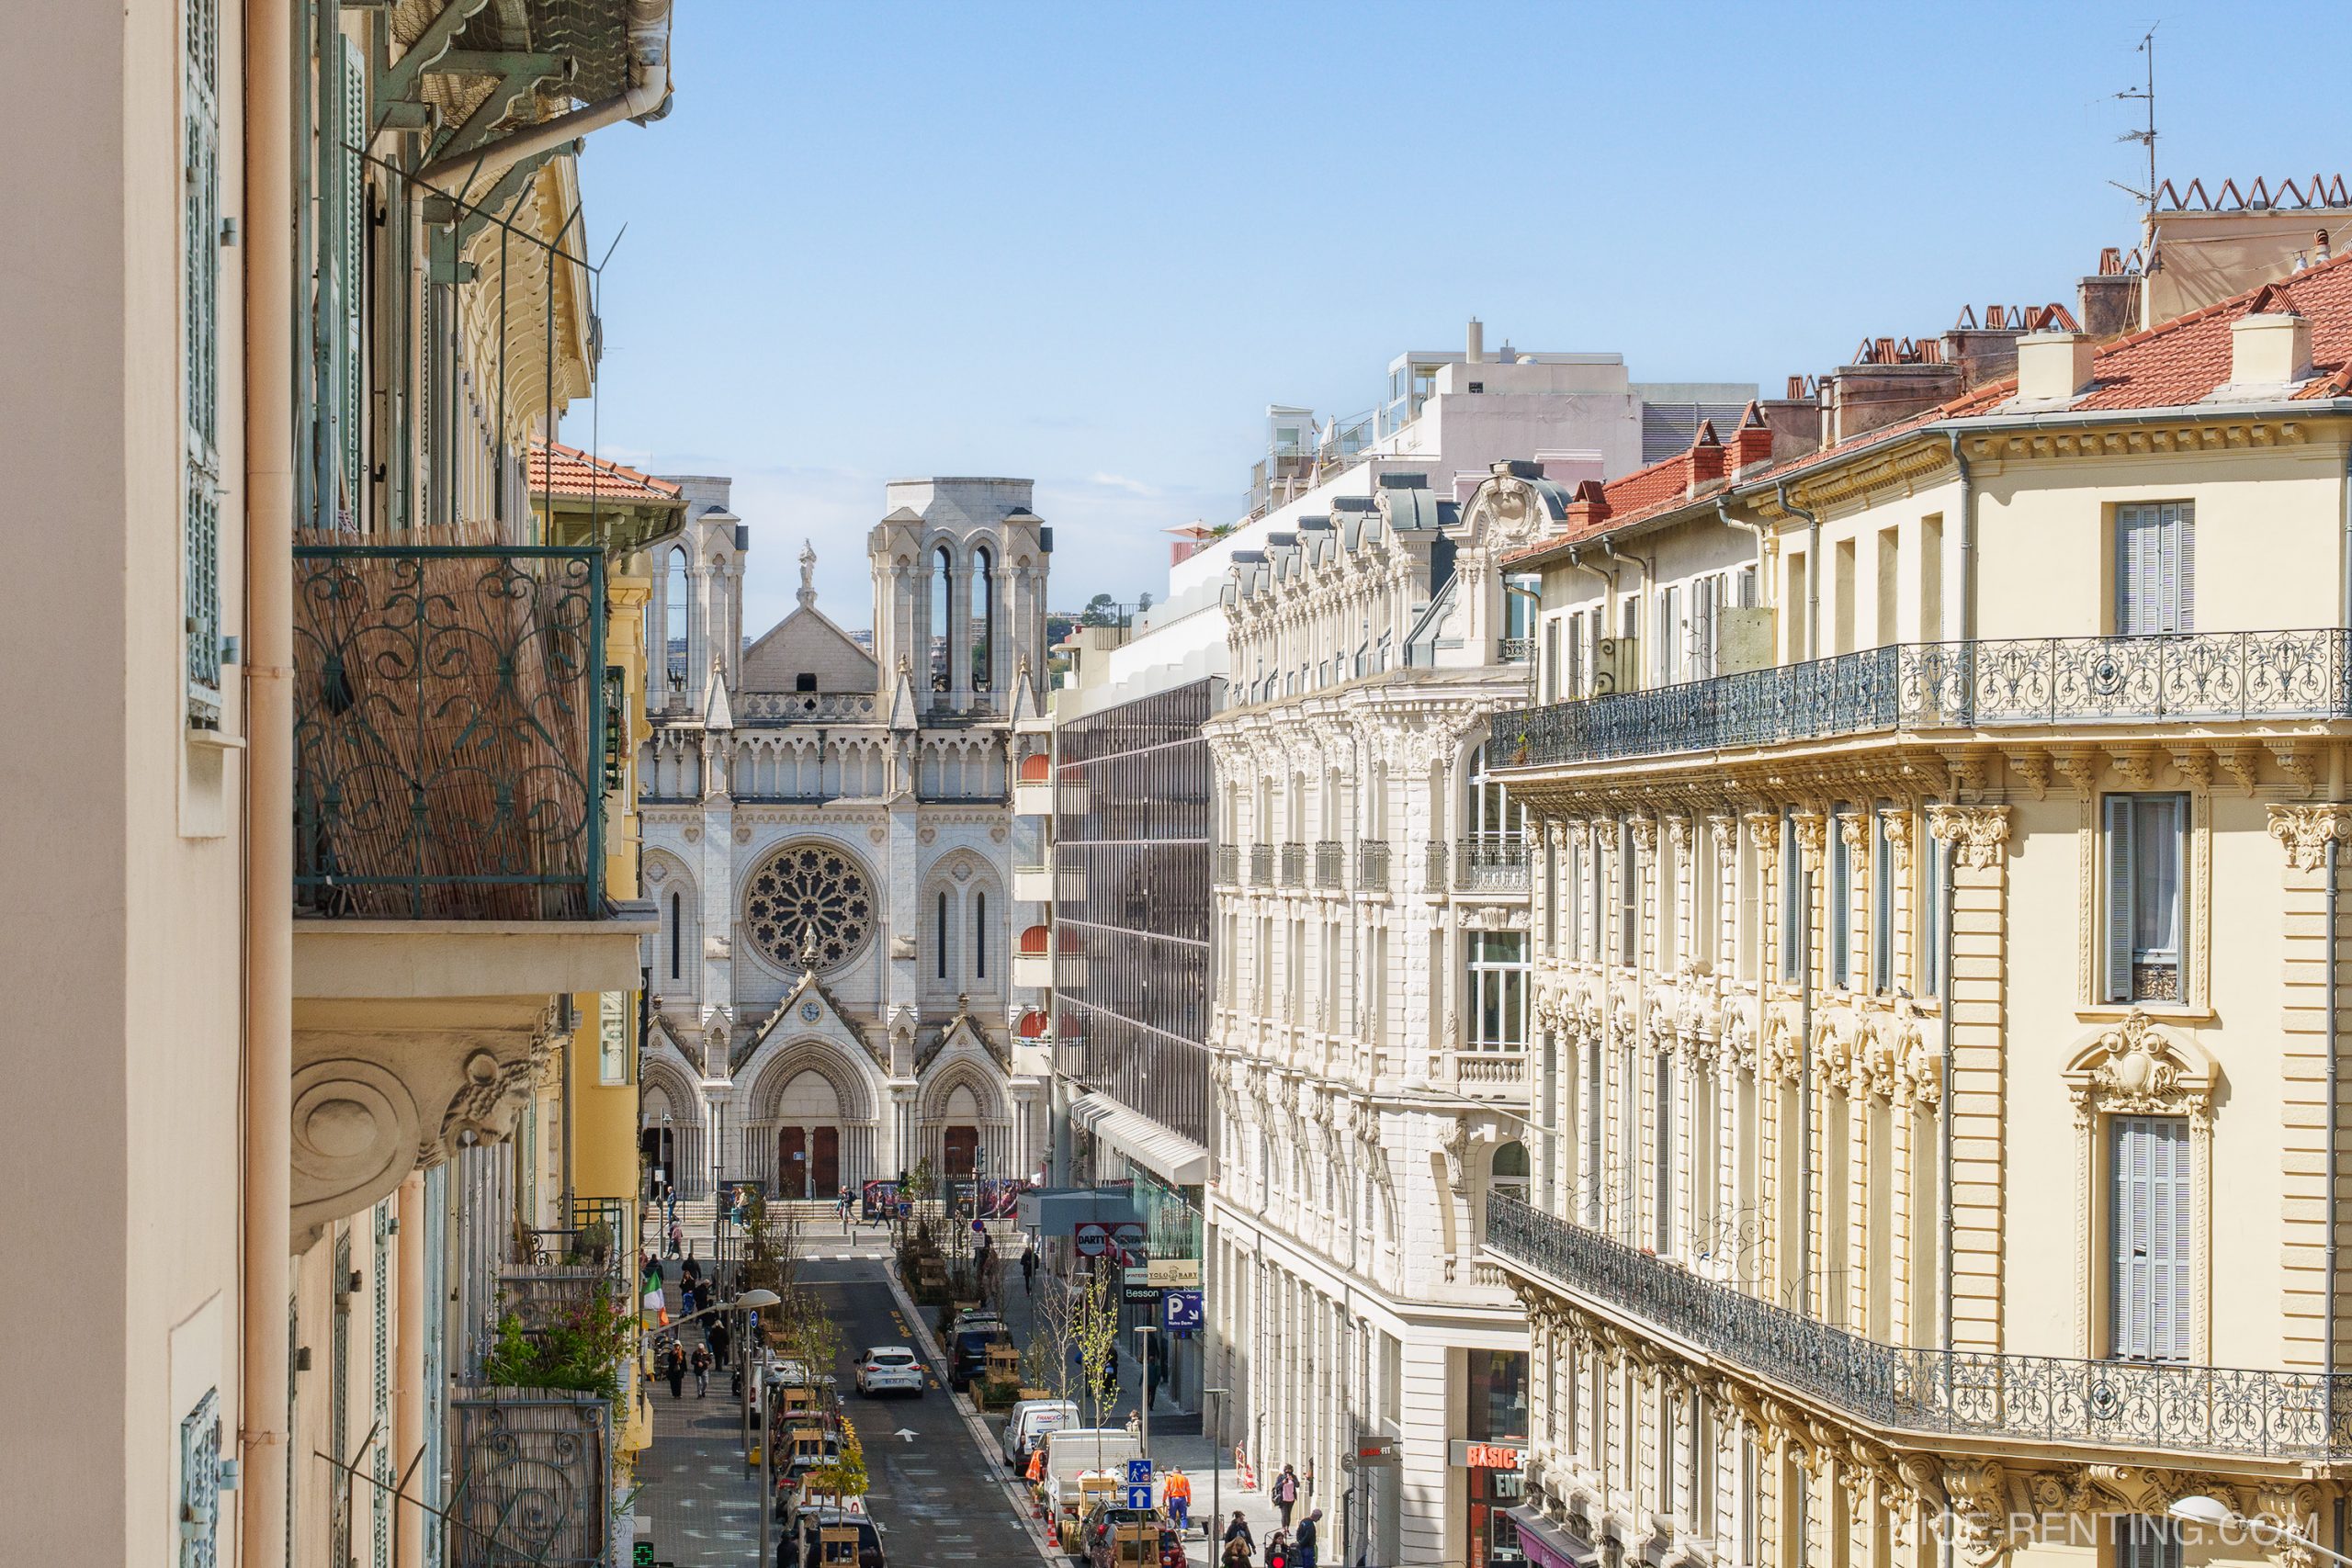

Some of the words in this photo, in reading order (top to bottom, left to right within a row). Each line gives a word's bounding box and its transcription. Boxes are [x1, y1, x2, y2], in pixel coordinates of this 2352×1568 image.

[1079, 1235, 1105, 1244] DARTY
[1125, 1289, 1159, 1297] Besson
[1168, 1298, 1183, 1320] P
[1466, 1443, 1527, 1470] BASIC-F
[1495, 1474, 1525, 1497] ENT
